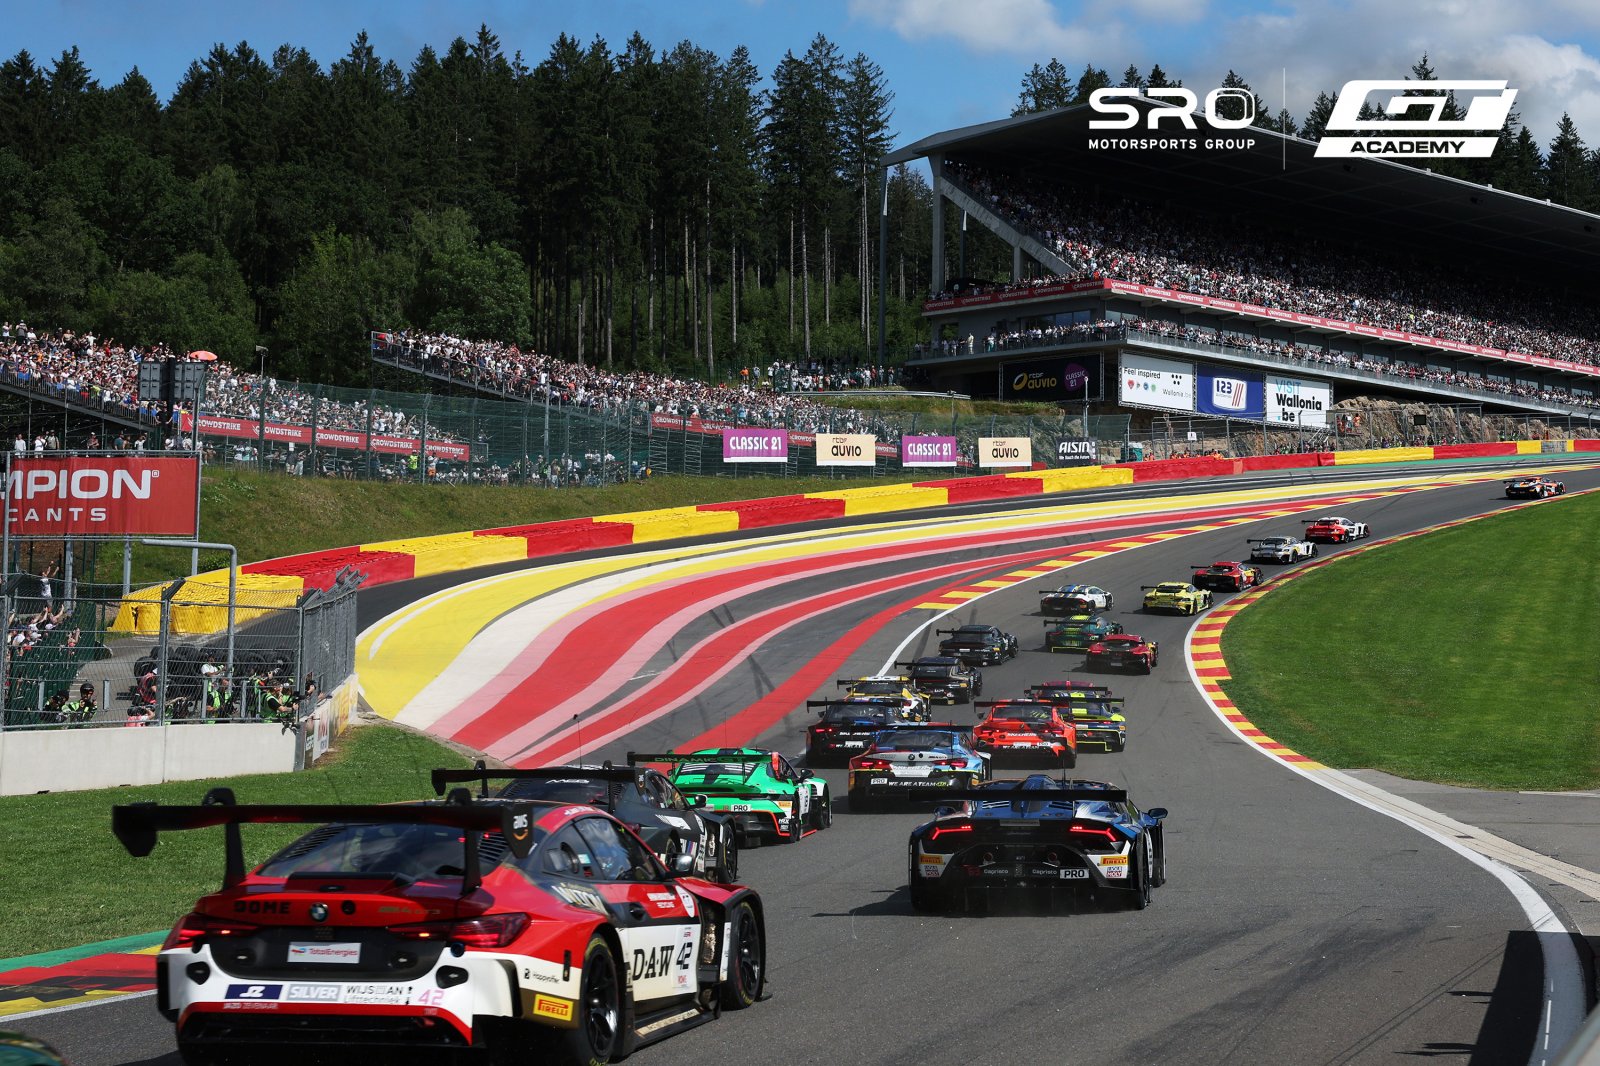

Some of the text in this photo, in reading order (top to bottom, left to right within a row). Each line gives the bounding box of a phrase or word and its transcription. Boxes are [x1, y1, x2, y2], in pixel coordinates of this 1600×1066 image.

[1065, 370, 1085, 380] CLASSIC
[1124, 367, 1161, 379] Feel inspired
[1027, 378, 1057, 389] auvio
[1216, 380, 1232, 394] 123
[1275, 379, 1301, 394] VISIT
[1276, 393, 1322, 411] Wallonia
[255, 424, 302, 437] COWDSTRIKE
[316, 432, 359, 444] CROWDSTRIKE
[730, 436, 782, 450] CLASSIC 21
[831, 444, 862, 457] auvio
[908, 443, 941, 456] CLASSIC
[943, 443, 952, 455] 21
[991, 447, 1019, 459] auvio
[1058, 441, 1090, 454] AISIN
[733, 804, 748, 812] PRO
[1064, 869, 1085, 878] PRO
[309, 947, 359, 957] TotalEnergies
[676, 942, 693, 970] 42
[289, 986, 338, 999] SILVER
[418, 988, 444, 1005] 42
[538, 999, 569, 1016] PIRELLI
